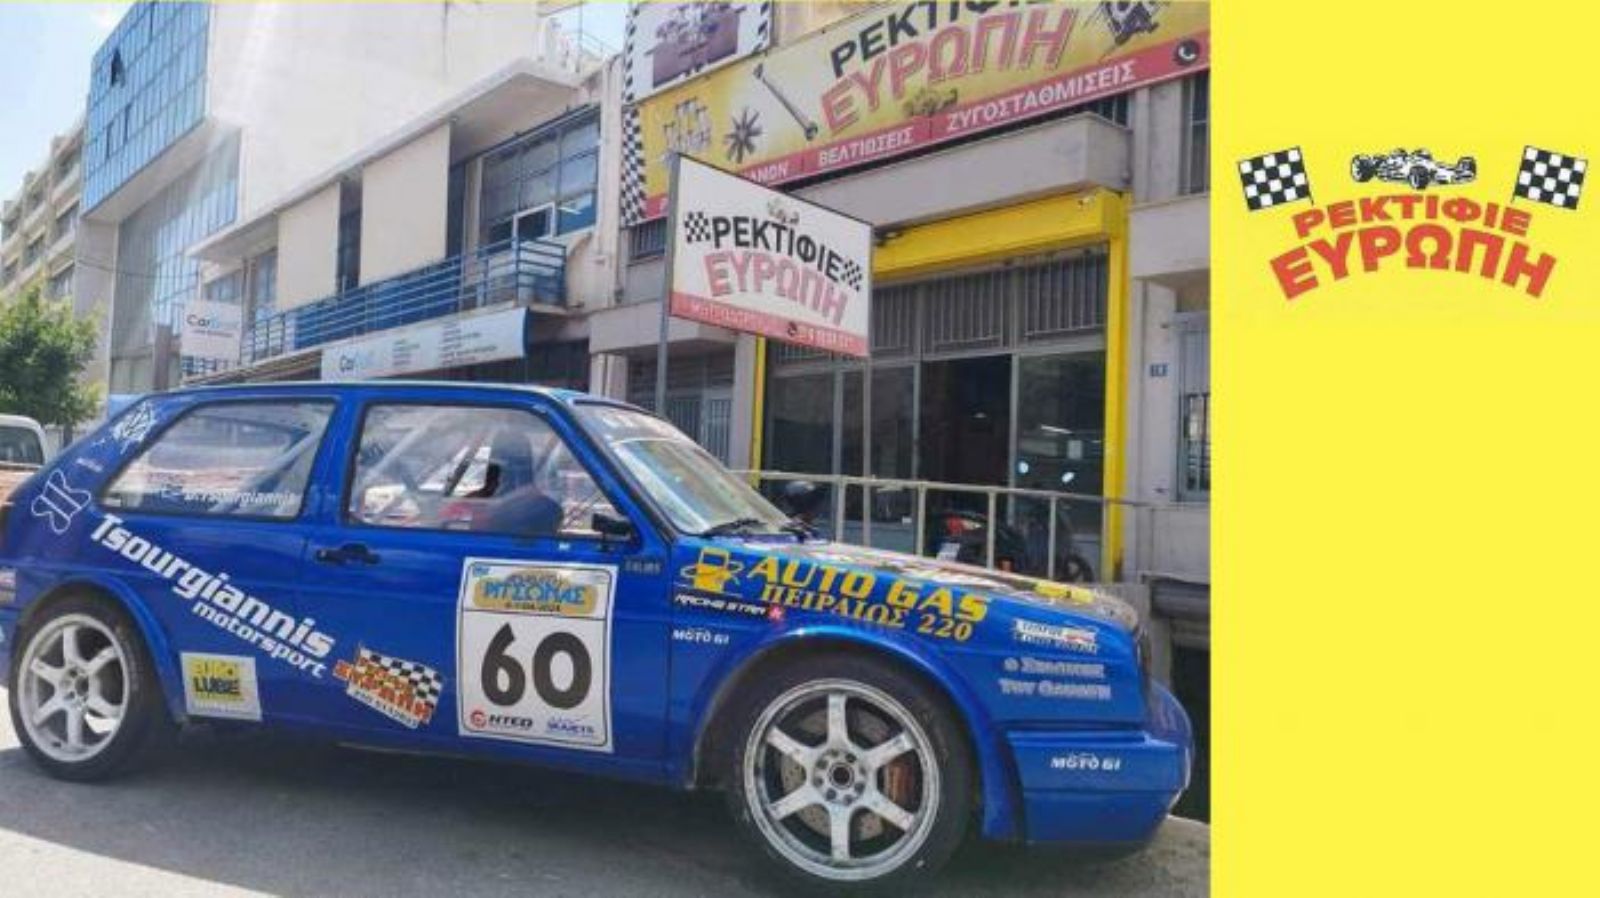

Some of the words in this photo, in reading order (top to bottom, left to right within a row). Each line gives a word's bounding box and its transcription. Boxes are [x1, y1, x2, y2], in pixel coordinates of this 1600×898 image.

[821, 7, 1079, 135] ΕΥΡΩΠΗ
[829, 0, 1056, 78] ΡΕΚΤΙ
[817, 126, 915, 168] ΒΕΛΤΙΩΣΕΙΣ
[946, 58, 1138, 133] ΖΥΓΟΣΤΑΘΜΙΣΕΙΣ
[703, 249, 849, 328] ΕΥΡΩΠΗ
[712, 216, 842, 284] ΡΕΚΤΙΦΙΕ
[90, 512, 336, 658] Tsourgiannis
[747, 555, 876, 600] AUTO
[886, 577, 989, 622] GAS
[760, 582, 907, 628] ΠΕΙΡΑΙΩΣ
[916, 613, 973, 642] 220
[193, 600, 327, 678] motorsport
[481, 622, 592, 709] 60
